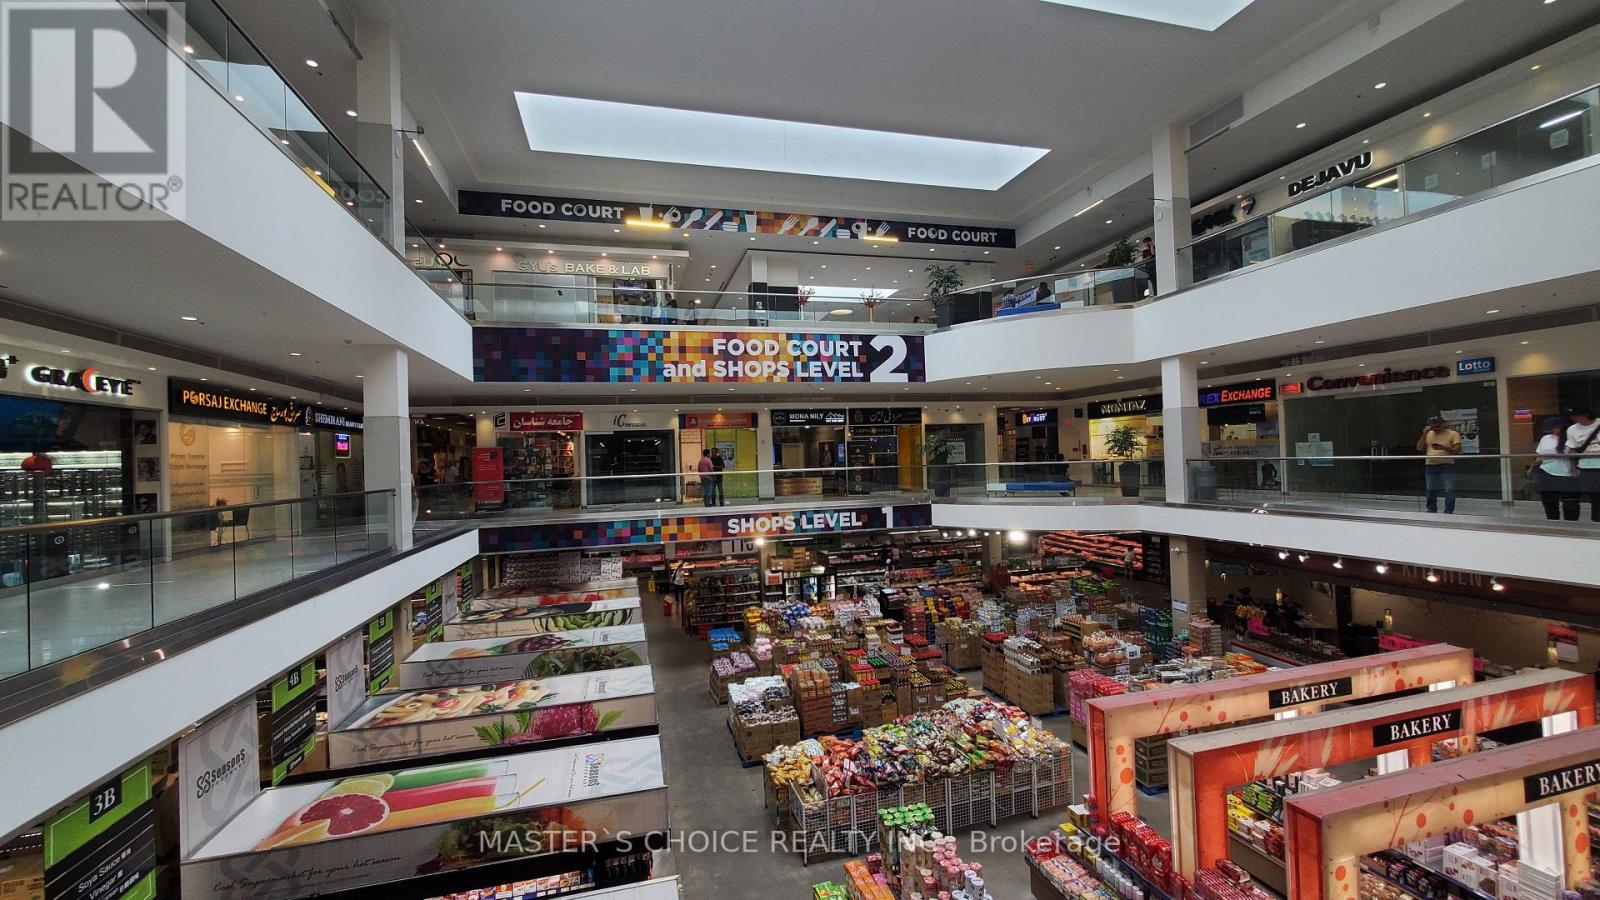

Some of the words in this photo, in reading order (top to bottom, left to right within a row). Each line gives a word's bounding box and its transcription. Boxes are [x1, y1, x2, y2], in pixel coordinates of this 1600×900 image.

[1288, 151, 1373, 197] DEJAVU
[501, 199, 555, 214] FOOD
[561, 203, 624, 219] COURT
[907, 226, 948, 240] FOOD
[952, 230, 998, 243] COURT
[565, 263, 604, 274] BAKE
[608, 264, 619, 275] &
[621, 264, 651, 276] LAB
[662, 359, 707, 378] and
[713, 360, 790, 378] SHOPS
[796, 361, 864, 378] LEVEL
[869, 335, 909, 383] 2
[712, 338, 780, 356] FOOD
[787, 340, 863, 357] COURT
[1458, 358, 1491, 372] Lotto
[1306, 364, 1451, 391] Convenience
[223, 396, 268, 416] EXCHANGE
[1221, 386, 1272, 403] EXCHANGE
[727, 514, 796, 534] SHOPS
[801, 511, 862, 530] LEVEL
[880, 506, 894, 529] 1
[289, 671, 299, 687] 4B
[1281, 681, 1339, 705] BAKERY
[1390, 713, 1452, 742] BAKERY
[1539, 761, 1600, 797] BAKERY
[93, 787, 116, 816] 3B
[78, 874, 98, 893] Soya
[239, 869, 306, 890] Supermarket
[304, 868, 323, 881] for
[325, 864, 349, 878] your
[352, 859, 373, 869] hot
[89, 876, 117, 900] Vinegar
